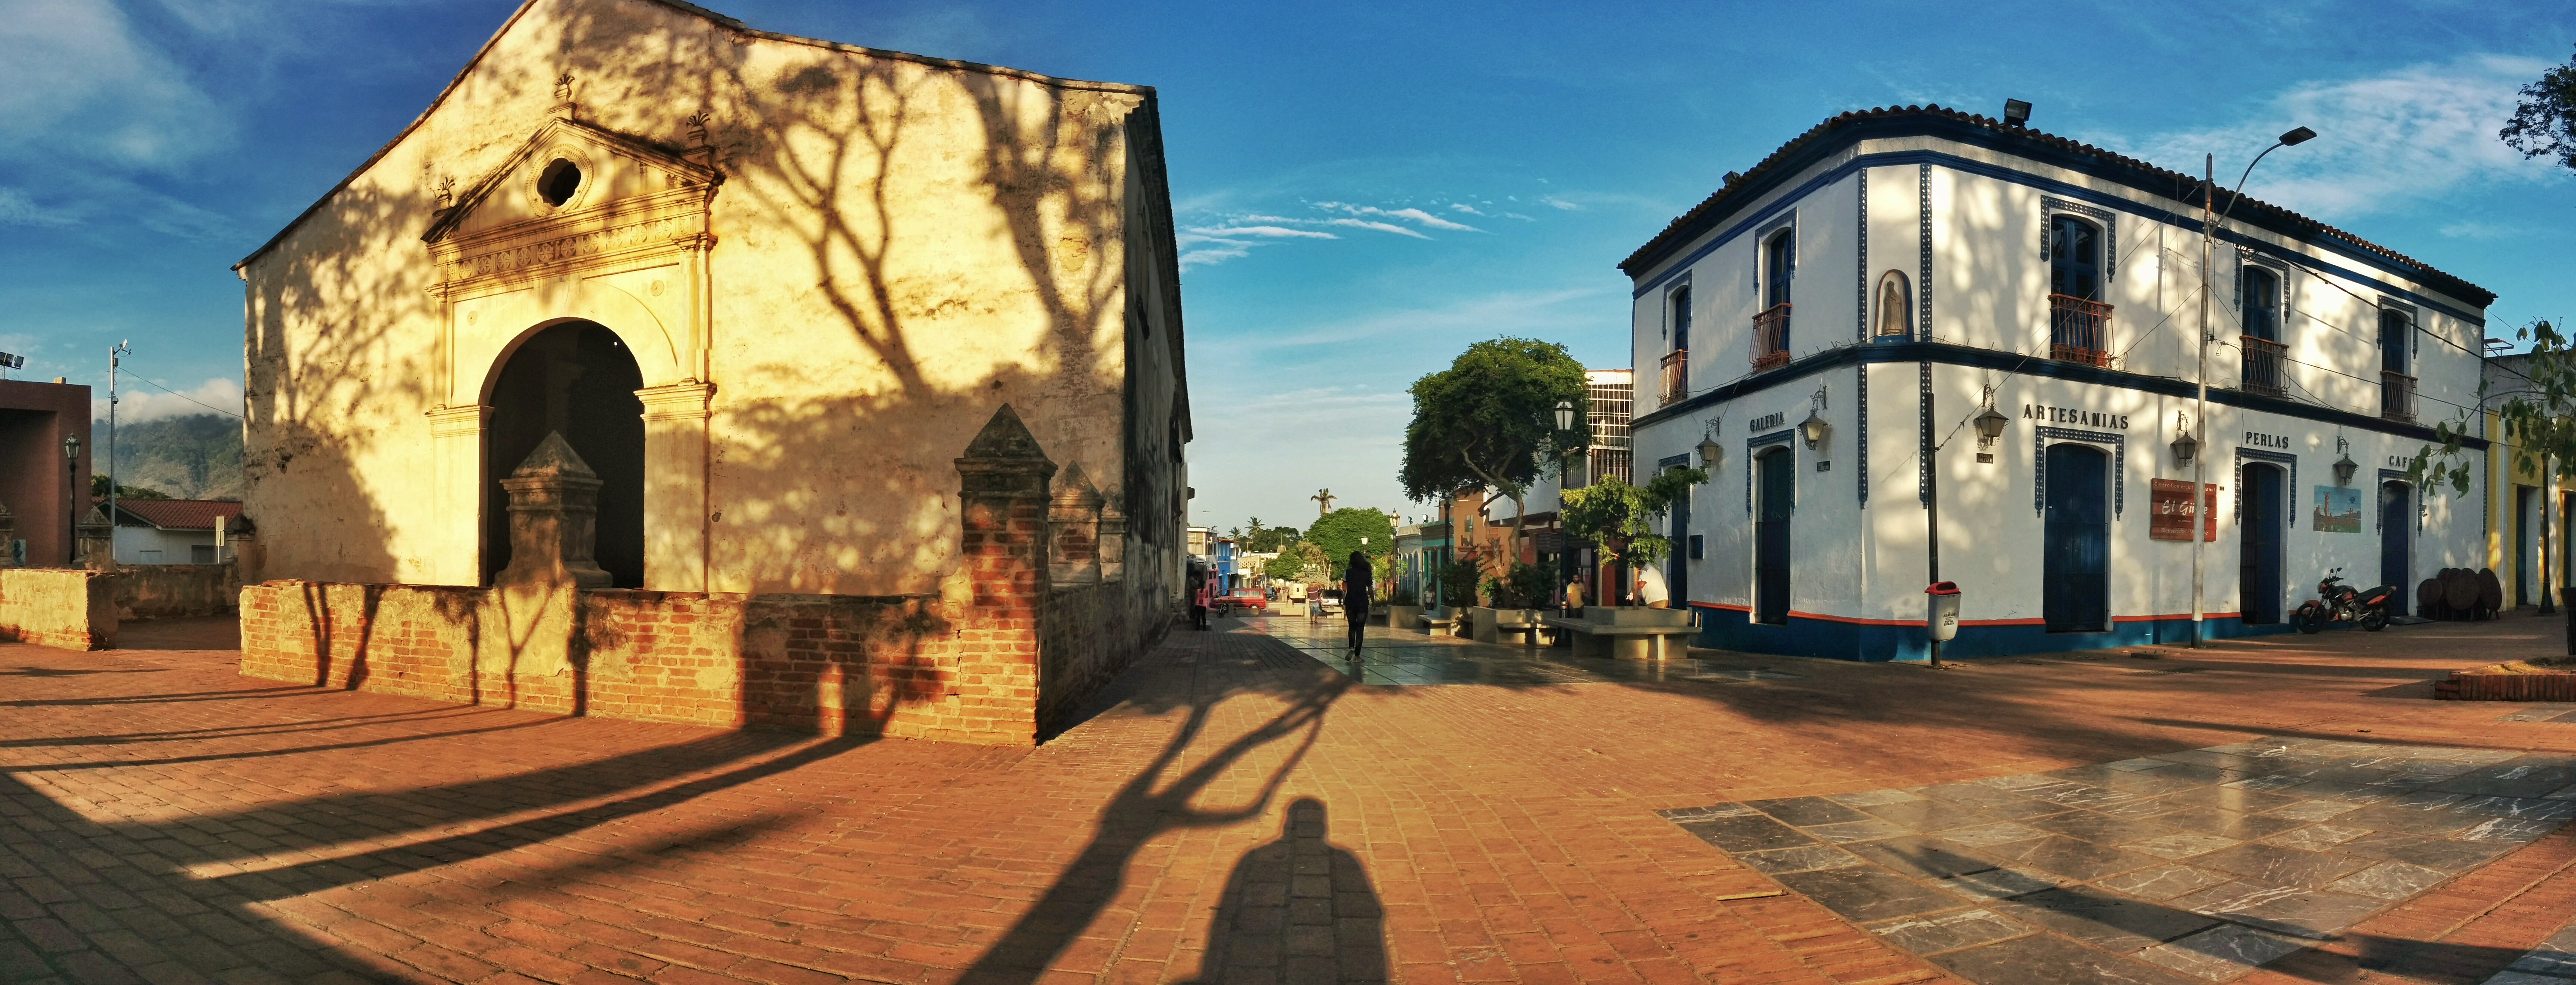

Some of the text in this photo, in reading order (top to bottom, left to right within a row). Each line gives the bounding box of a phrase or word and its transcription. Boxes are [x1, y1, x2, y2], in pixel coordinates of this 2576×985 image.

[1750, 411, 1785, 432] GALERIA
[2022, 404, 2129, 429] ARTESANIAS
[2245, 431, 2289, 449] PERLAS
[2162, 500, 2176, 515] El
